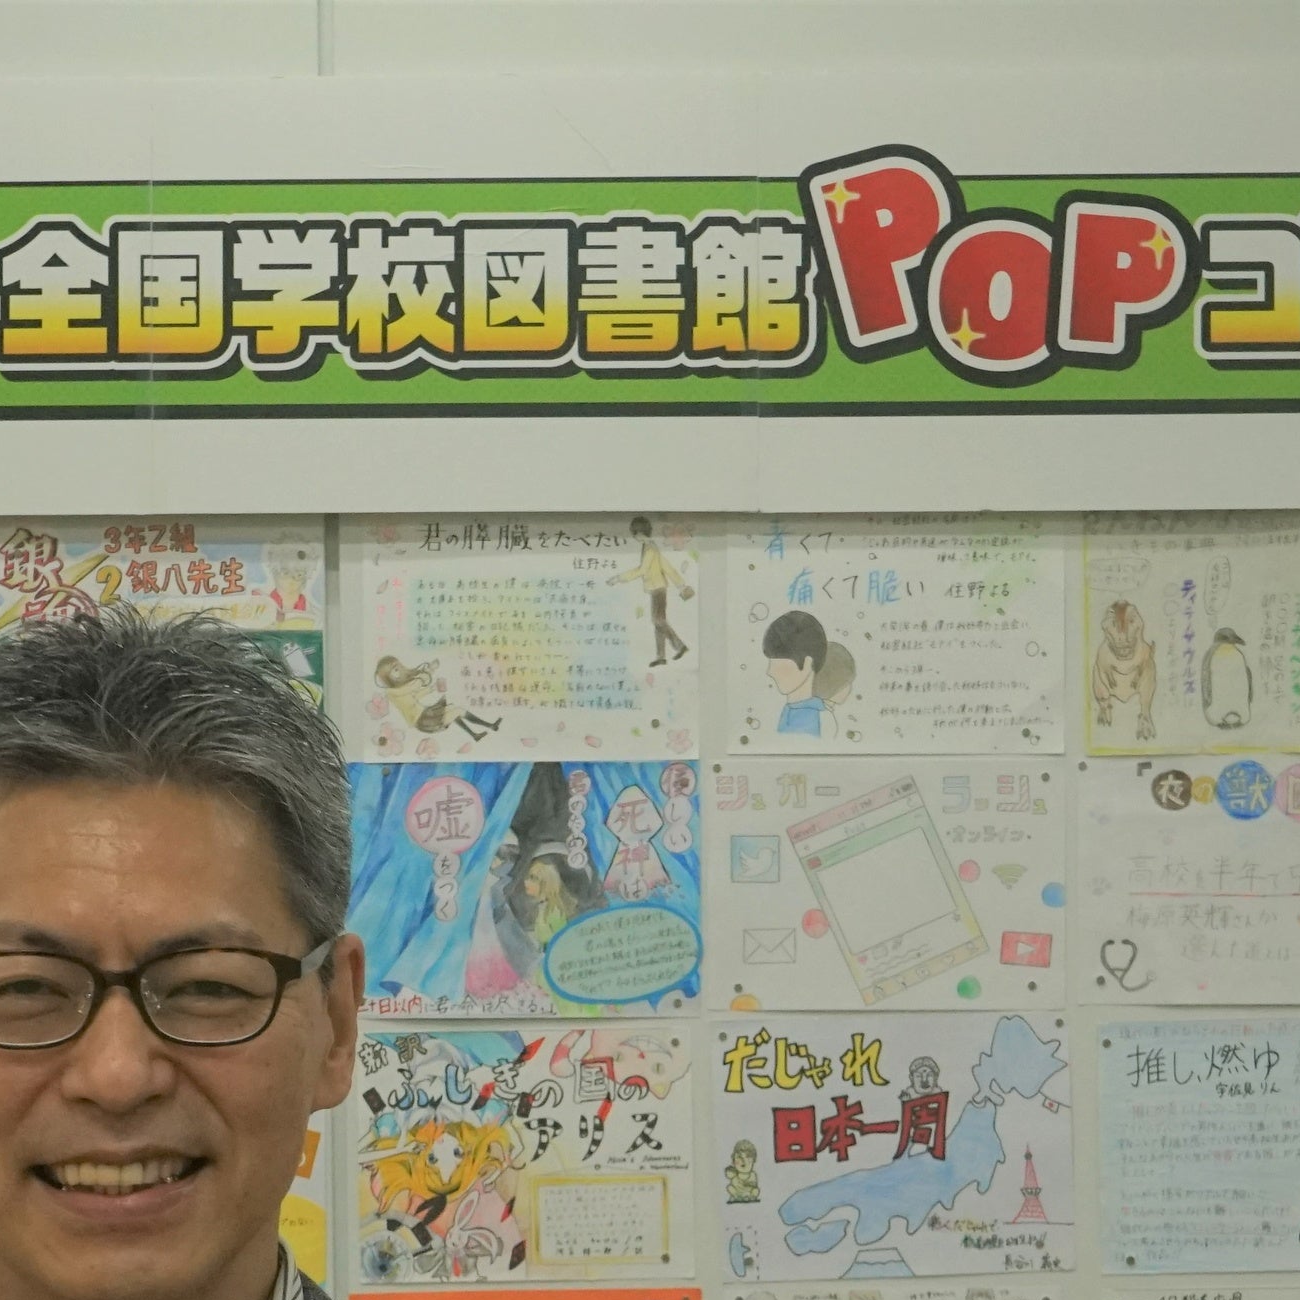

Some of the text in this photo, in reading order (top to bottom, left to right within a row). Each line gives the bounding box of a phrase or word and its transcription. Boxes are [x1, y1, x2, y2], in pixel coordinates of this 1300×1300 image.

[418, 521, 629, 552] 君の膵臓をたべたい
[129, 556, 245, 599] 銀八先生
[944, 579, 1011, 599] 住野よる
[412, 783, 482, 922] 嘘をつく
[387, 1056, 650, 1112] ふしぎの国の
[721, 1026, 891, 1095] だじゃれ
[1126, 1039, 1281, 1089] 推し、燃ゆ
[522, 1112, 664, 1163] アリス
[771, 1089, 952, 1164] 日本一周
